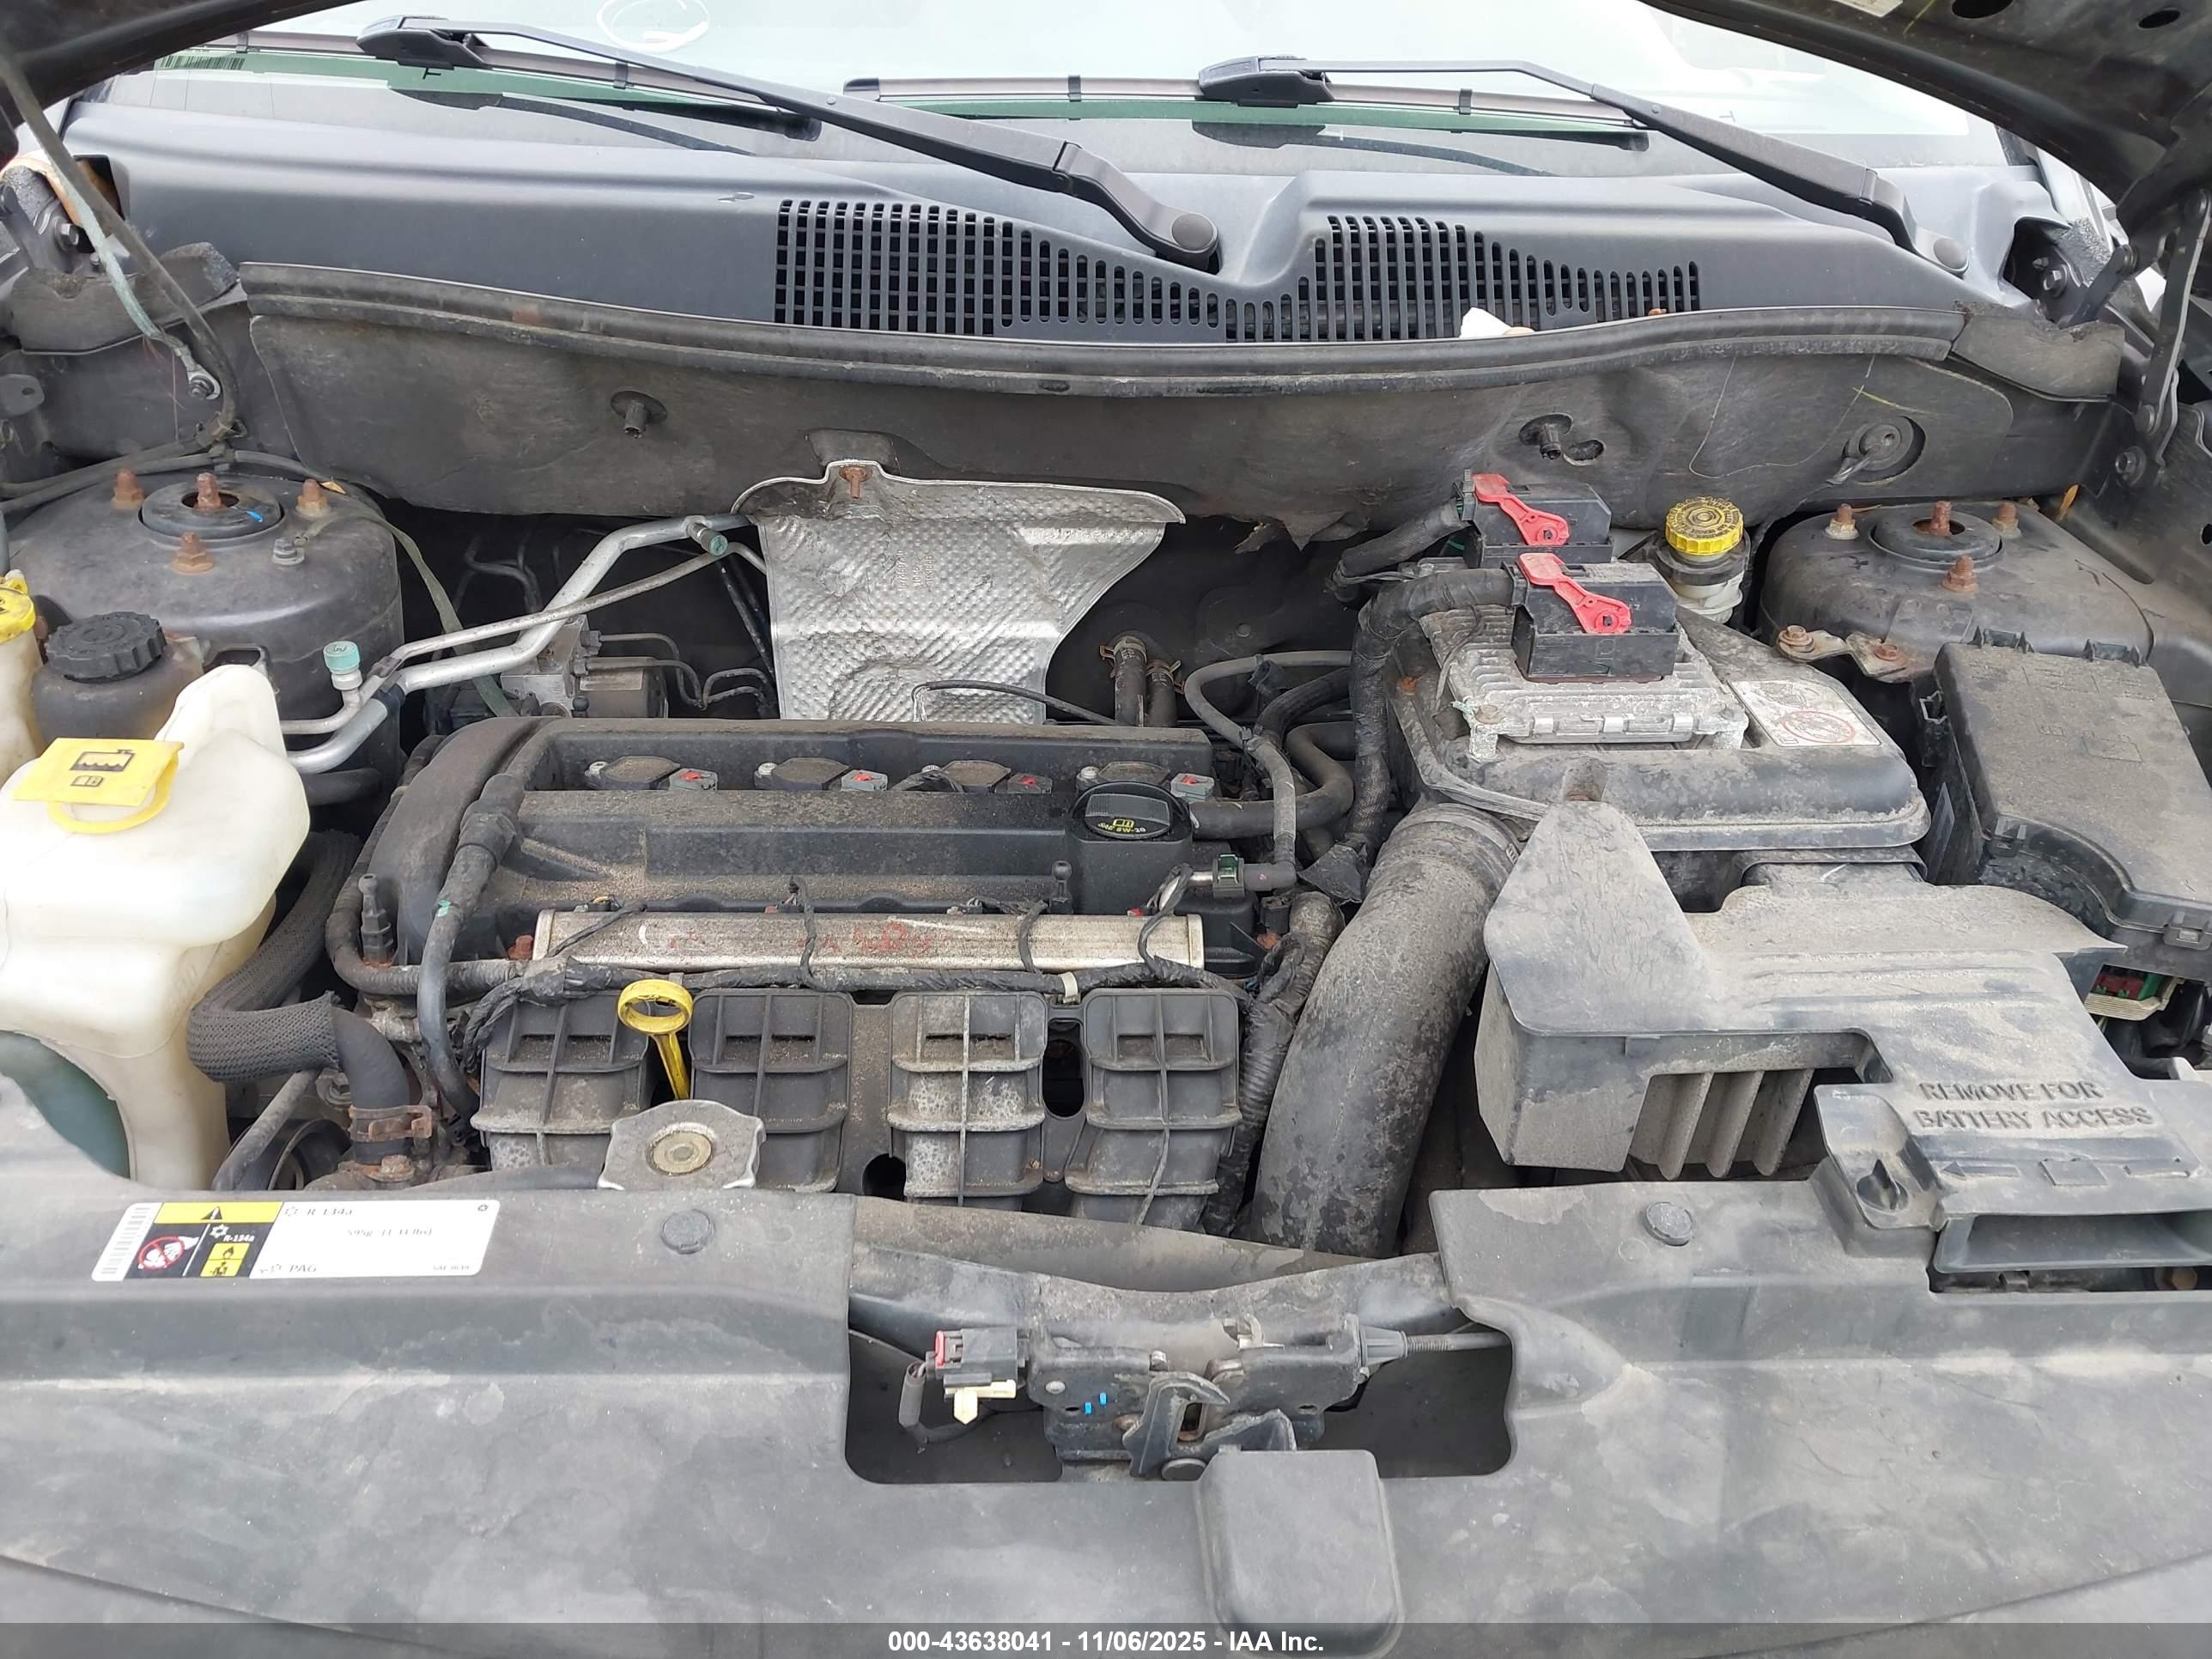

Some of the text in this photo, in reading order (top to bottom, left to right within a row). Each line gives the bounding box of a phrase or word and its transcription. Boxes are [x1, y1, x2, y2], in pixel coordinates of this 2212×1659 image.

[1918, 1081, 2105, 1101] REMOVE FOR
[1913, 1106, 2154, 1129] BATTERY ACCESS
[222, 1234, 256, 1243] R-134a
[289, 1264, 317, 1273] PAG
